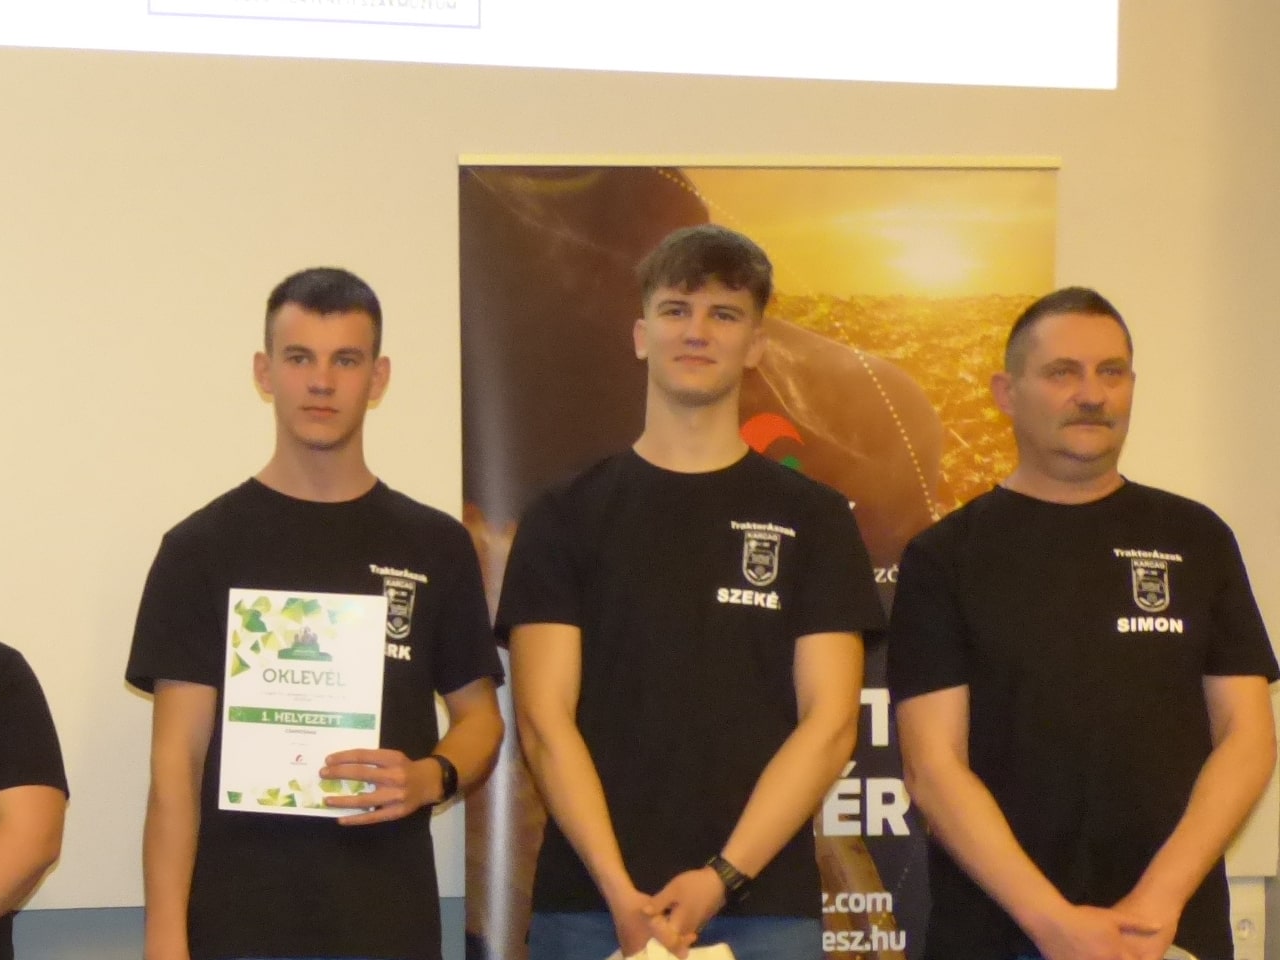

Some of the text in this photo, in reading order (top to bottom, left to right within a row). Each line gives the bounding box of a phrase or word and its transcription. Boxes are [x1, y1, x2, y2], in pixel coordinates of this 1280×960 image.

[716, 587, 782, 610] SZEKÉ
[1117, 616, 1184, 634] SIMON
[262, 667, 346, 687] OKLEVÉL
[274, 711, 344, 726] HELYEZETT
